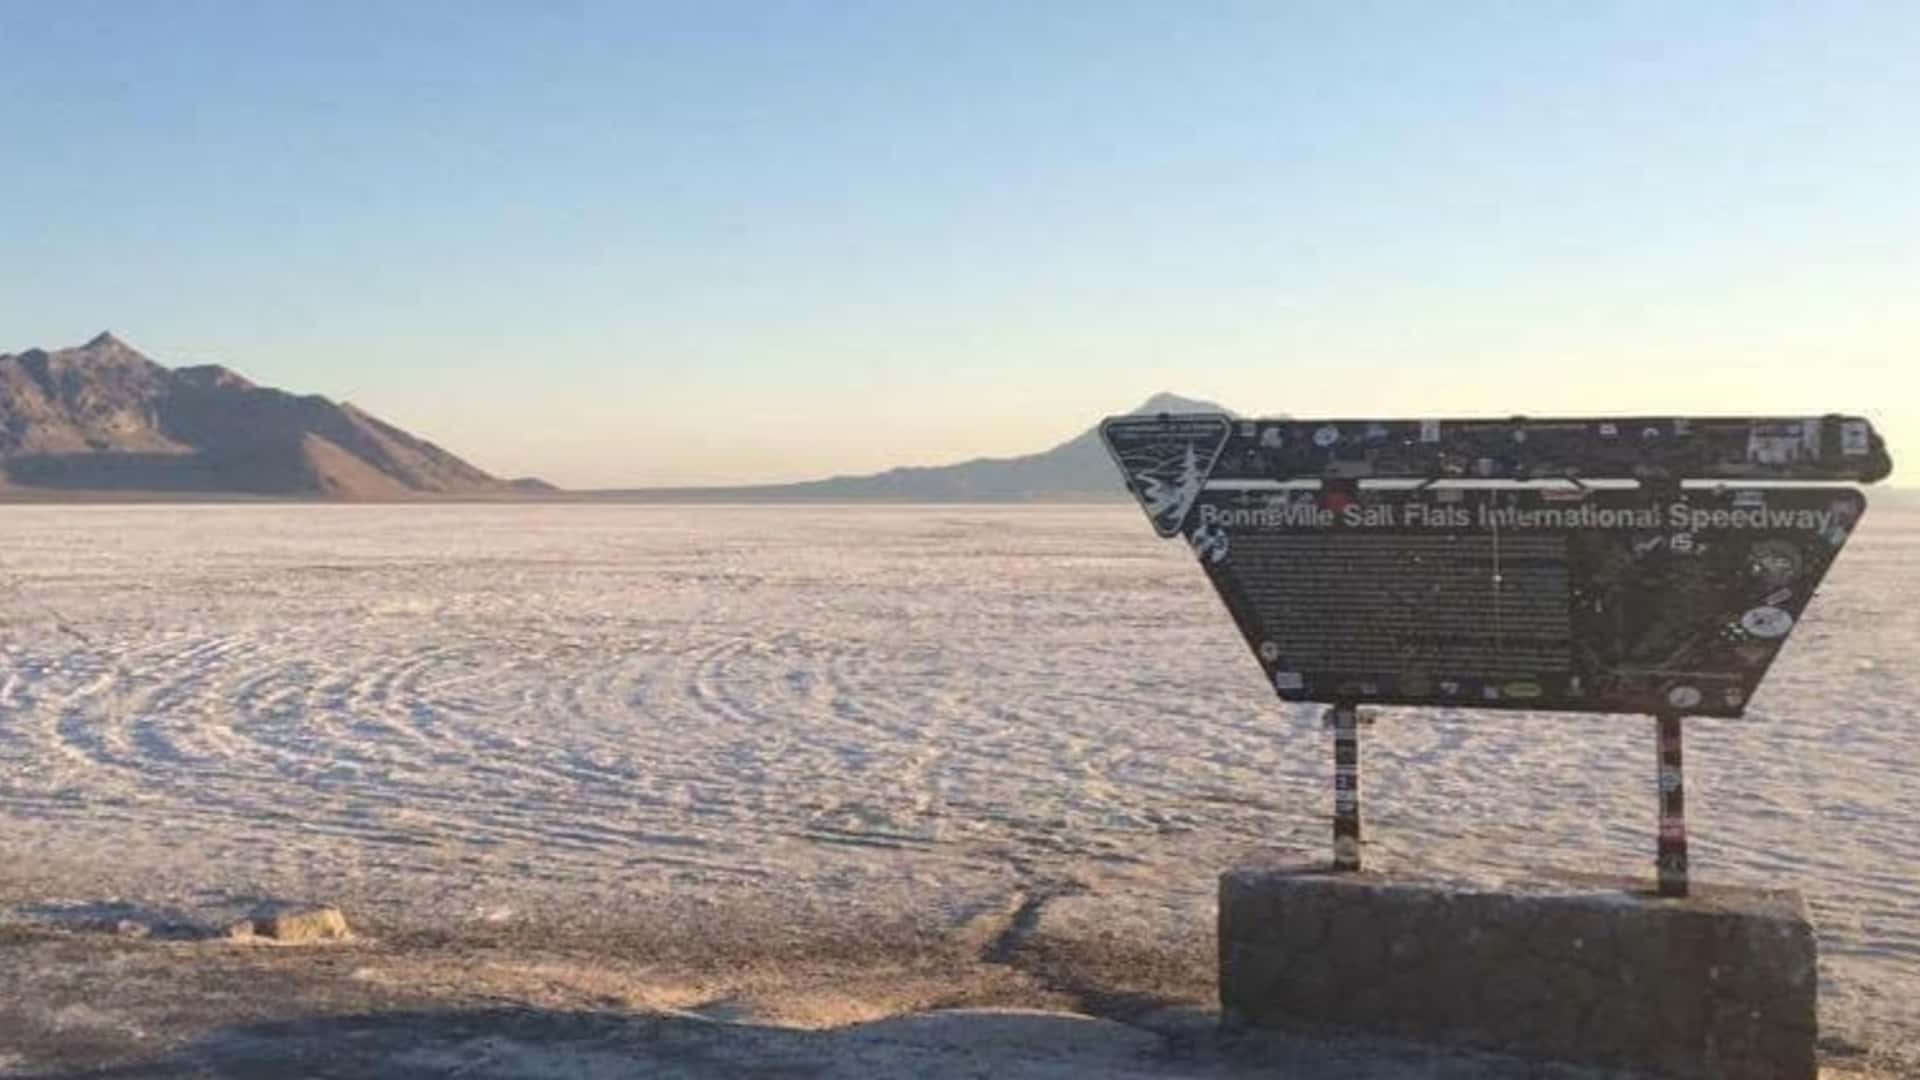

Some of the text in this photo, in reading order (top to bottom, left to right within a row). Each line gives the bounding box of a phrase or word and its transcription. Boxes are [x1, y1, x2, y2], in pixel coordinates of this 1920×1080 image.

[1200, 503, 1833, 533] Bonneville Salt Flats International Speedway
